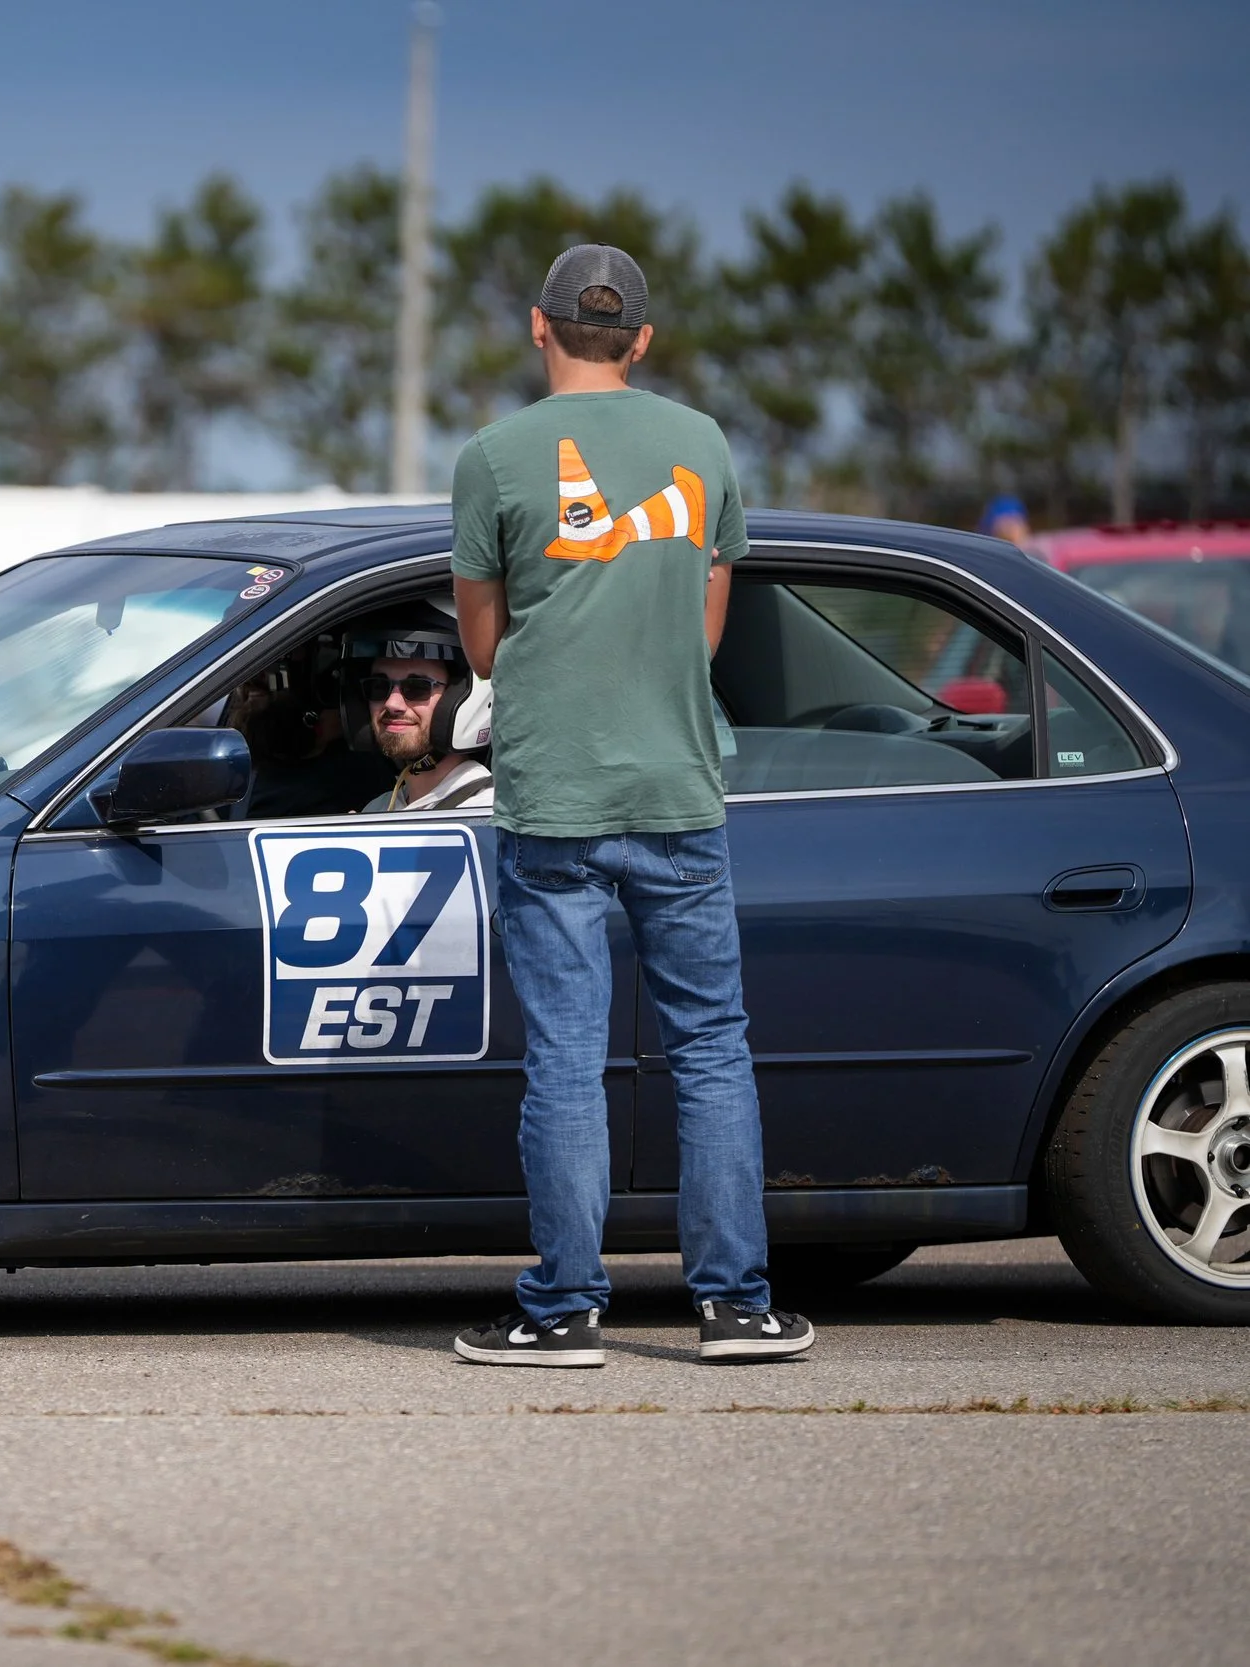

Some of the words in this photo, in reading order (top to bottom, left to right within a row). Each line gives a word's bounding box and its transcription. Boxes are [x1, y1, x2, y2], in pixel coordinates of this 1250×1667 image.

[1060, 753, 1082, 761] LEV
[274, 846, 467, 968] 87
[300, 984, 454, 1050] EST
